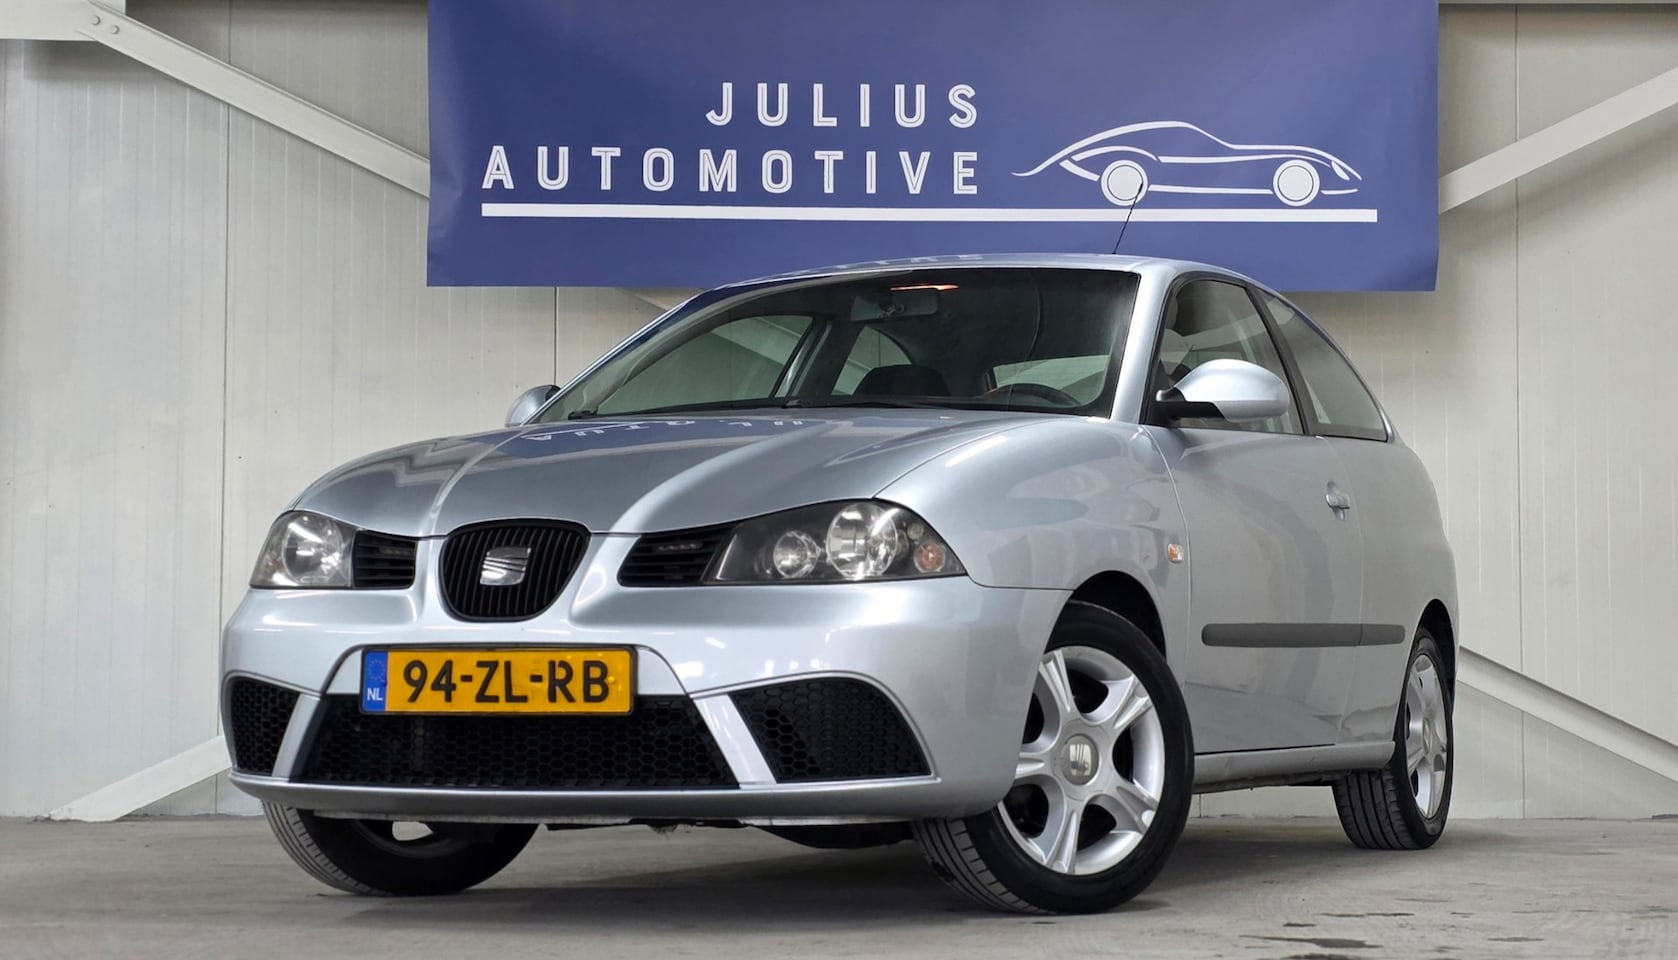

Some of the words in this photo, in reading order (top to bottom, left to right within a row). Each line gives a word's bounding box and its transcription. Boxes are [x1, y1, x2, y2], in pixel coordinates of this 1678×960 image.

[705, 82, 978, 128] JULIUS
[482, 145, 978, 194] AUTOMOTIVE
[366, 687, 383, 701] NL
[403, 659, 609, 703] 94-ZL-RB
